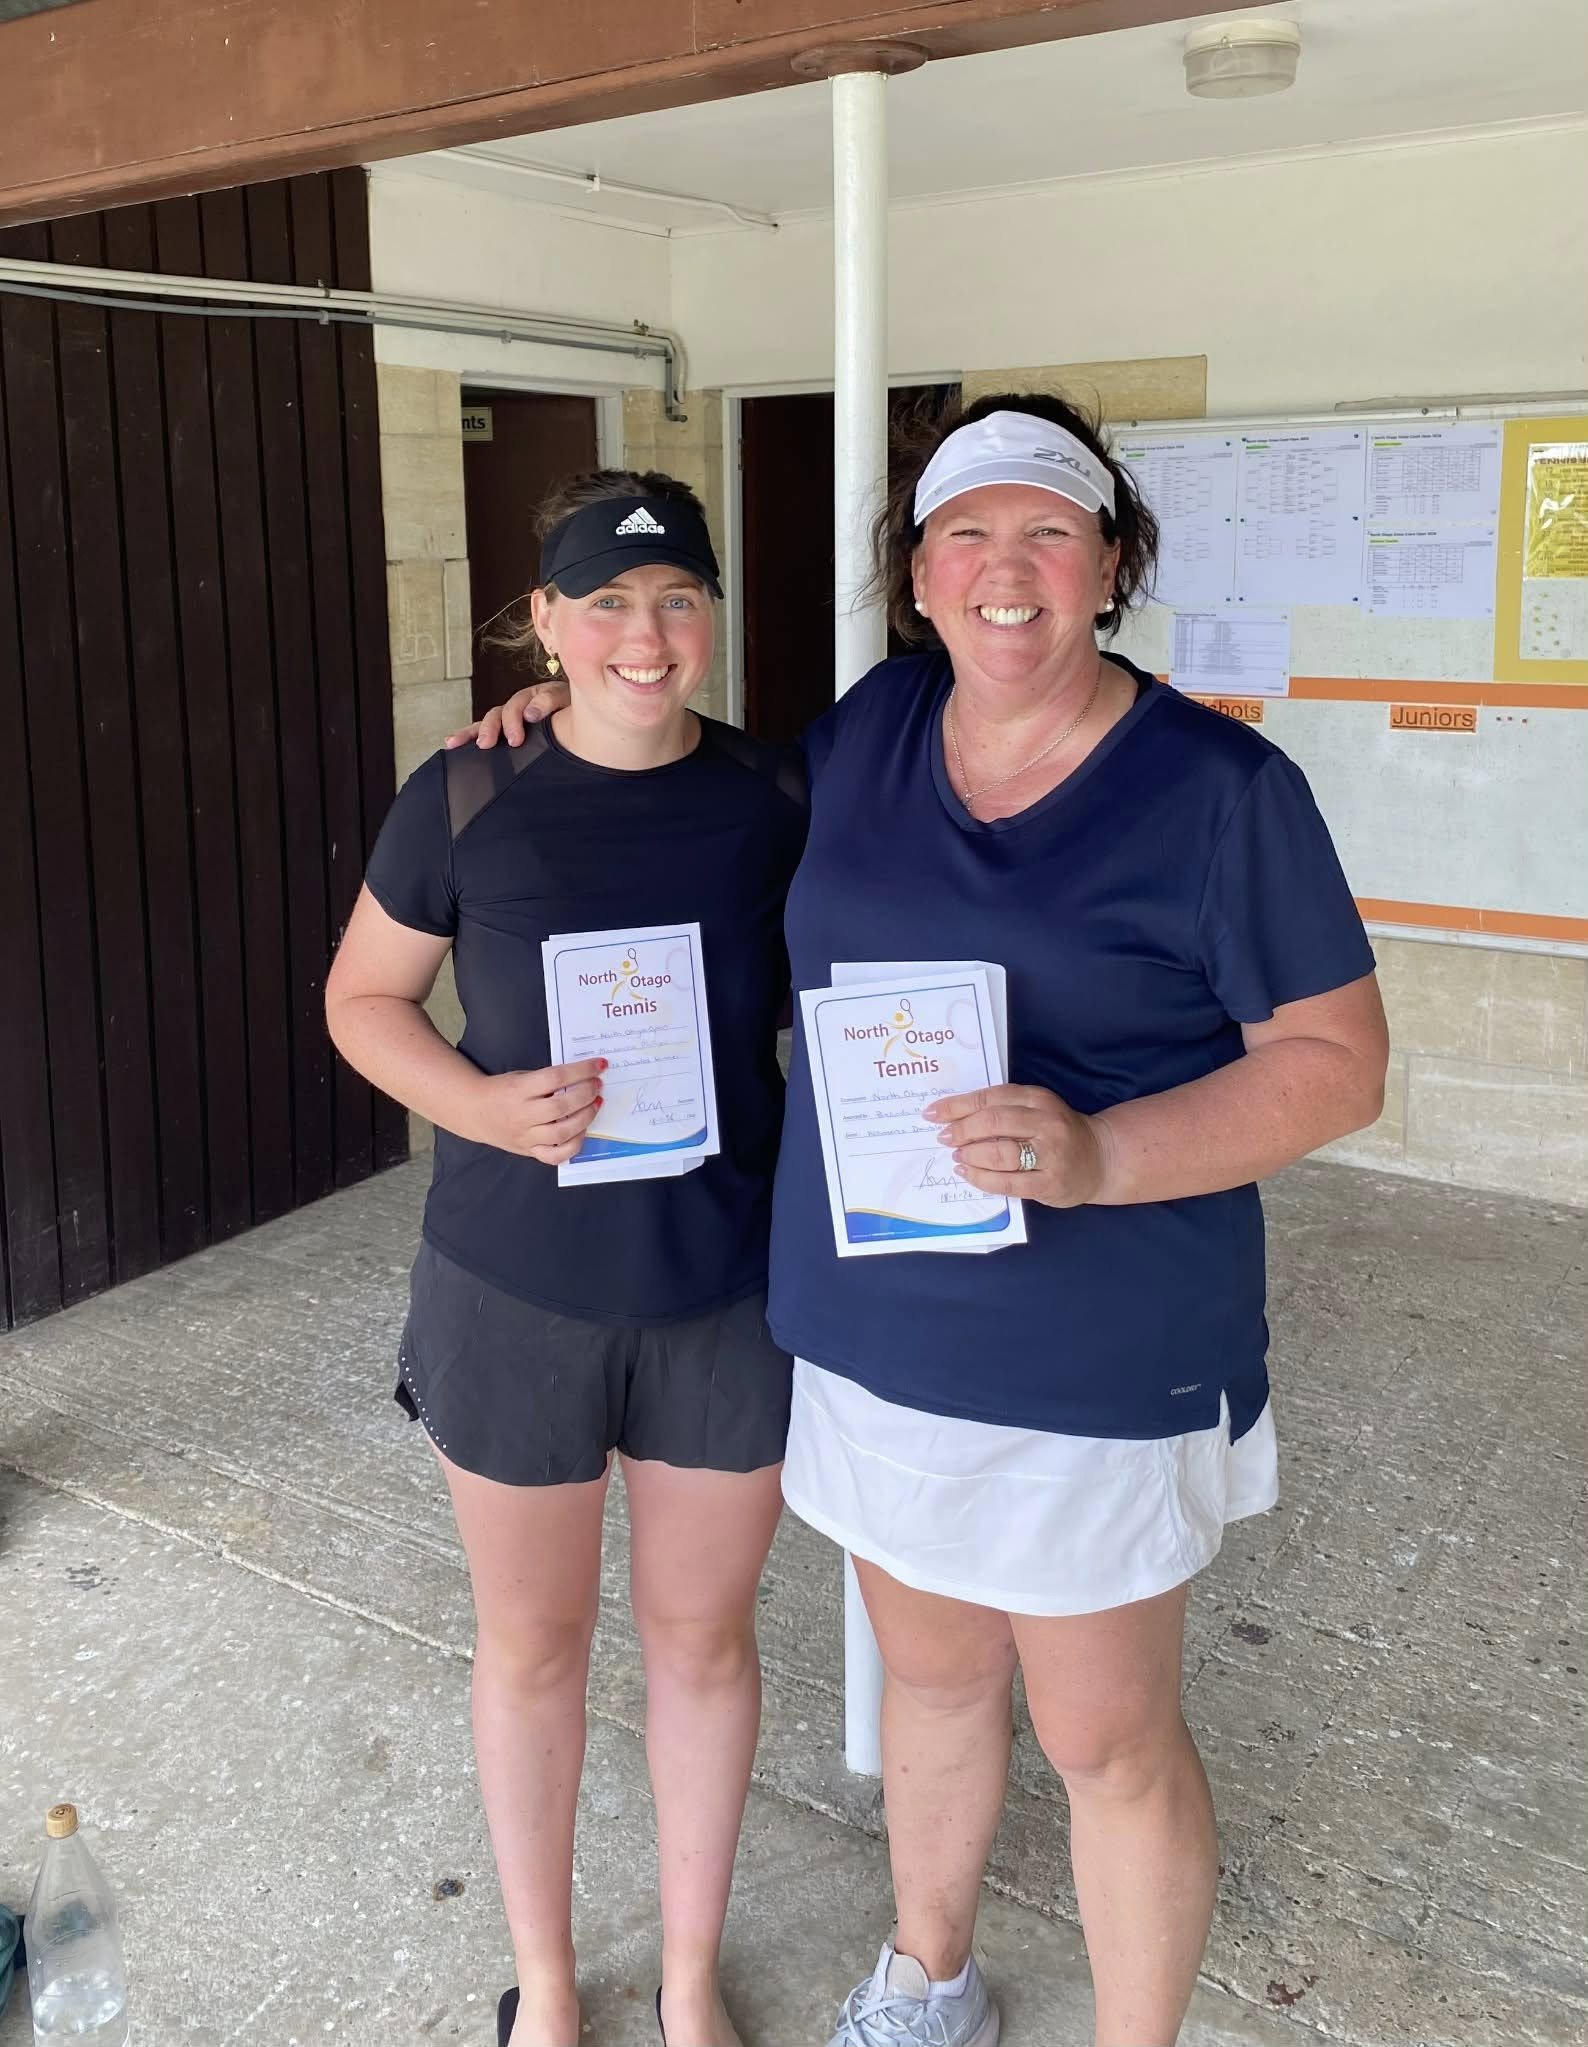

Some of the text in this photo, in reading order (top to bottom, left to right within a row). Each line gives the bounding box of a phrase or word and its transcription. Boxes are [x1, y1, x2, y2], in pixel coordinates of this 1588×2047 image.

[615, 522, 666, 536] adidas
[1392, 706, 1474, 728] Juniors
[578, 969, 672, 989] North Otago
[602, 997, 657, 1019] Tennis
[843, 1023, 955, 1045] North Otago
[873, 1056, 939, 1078] Tennis
